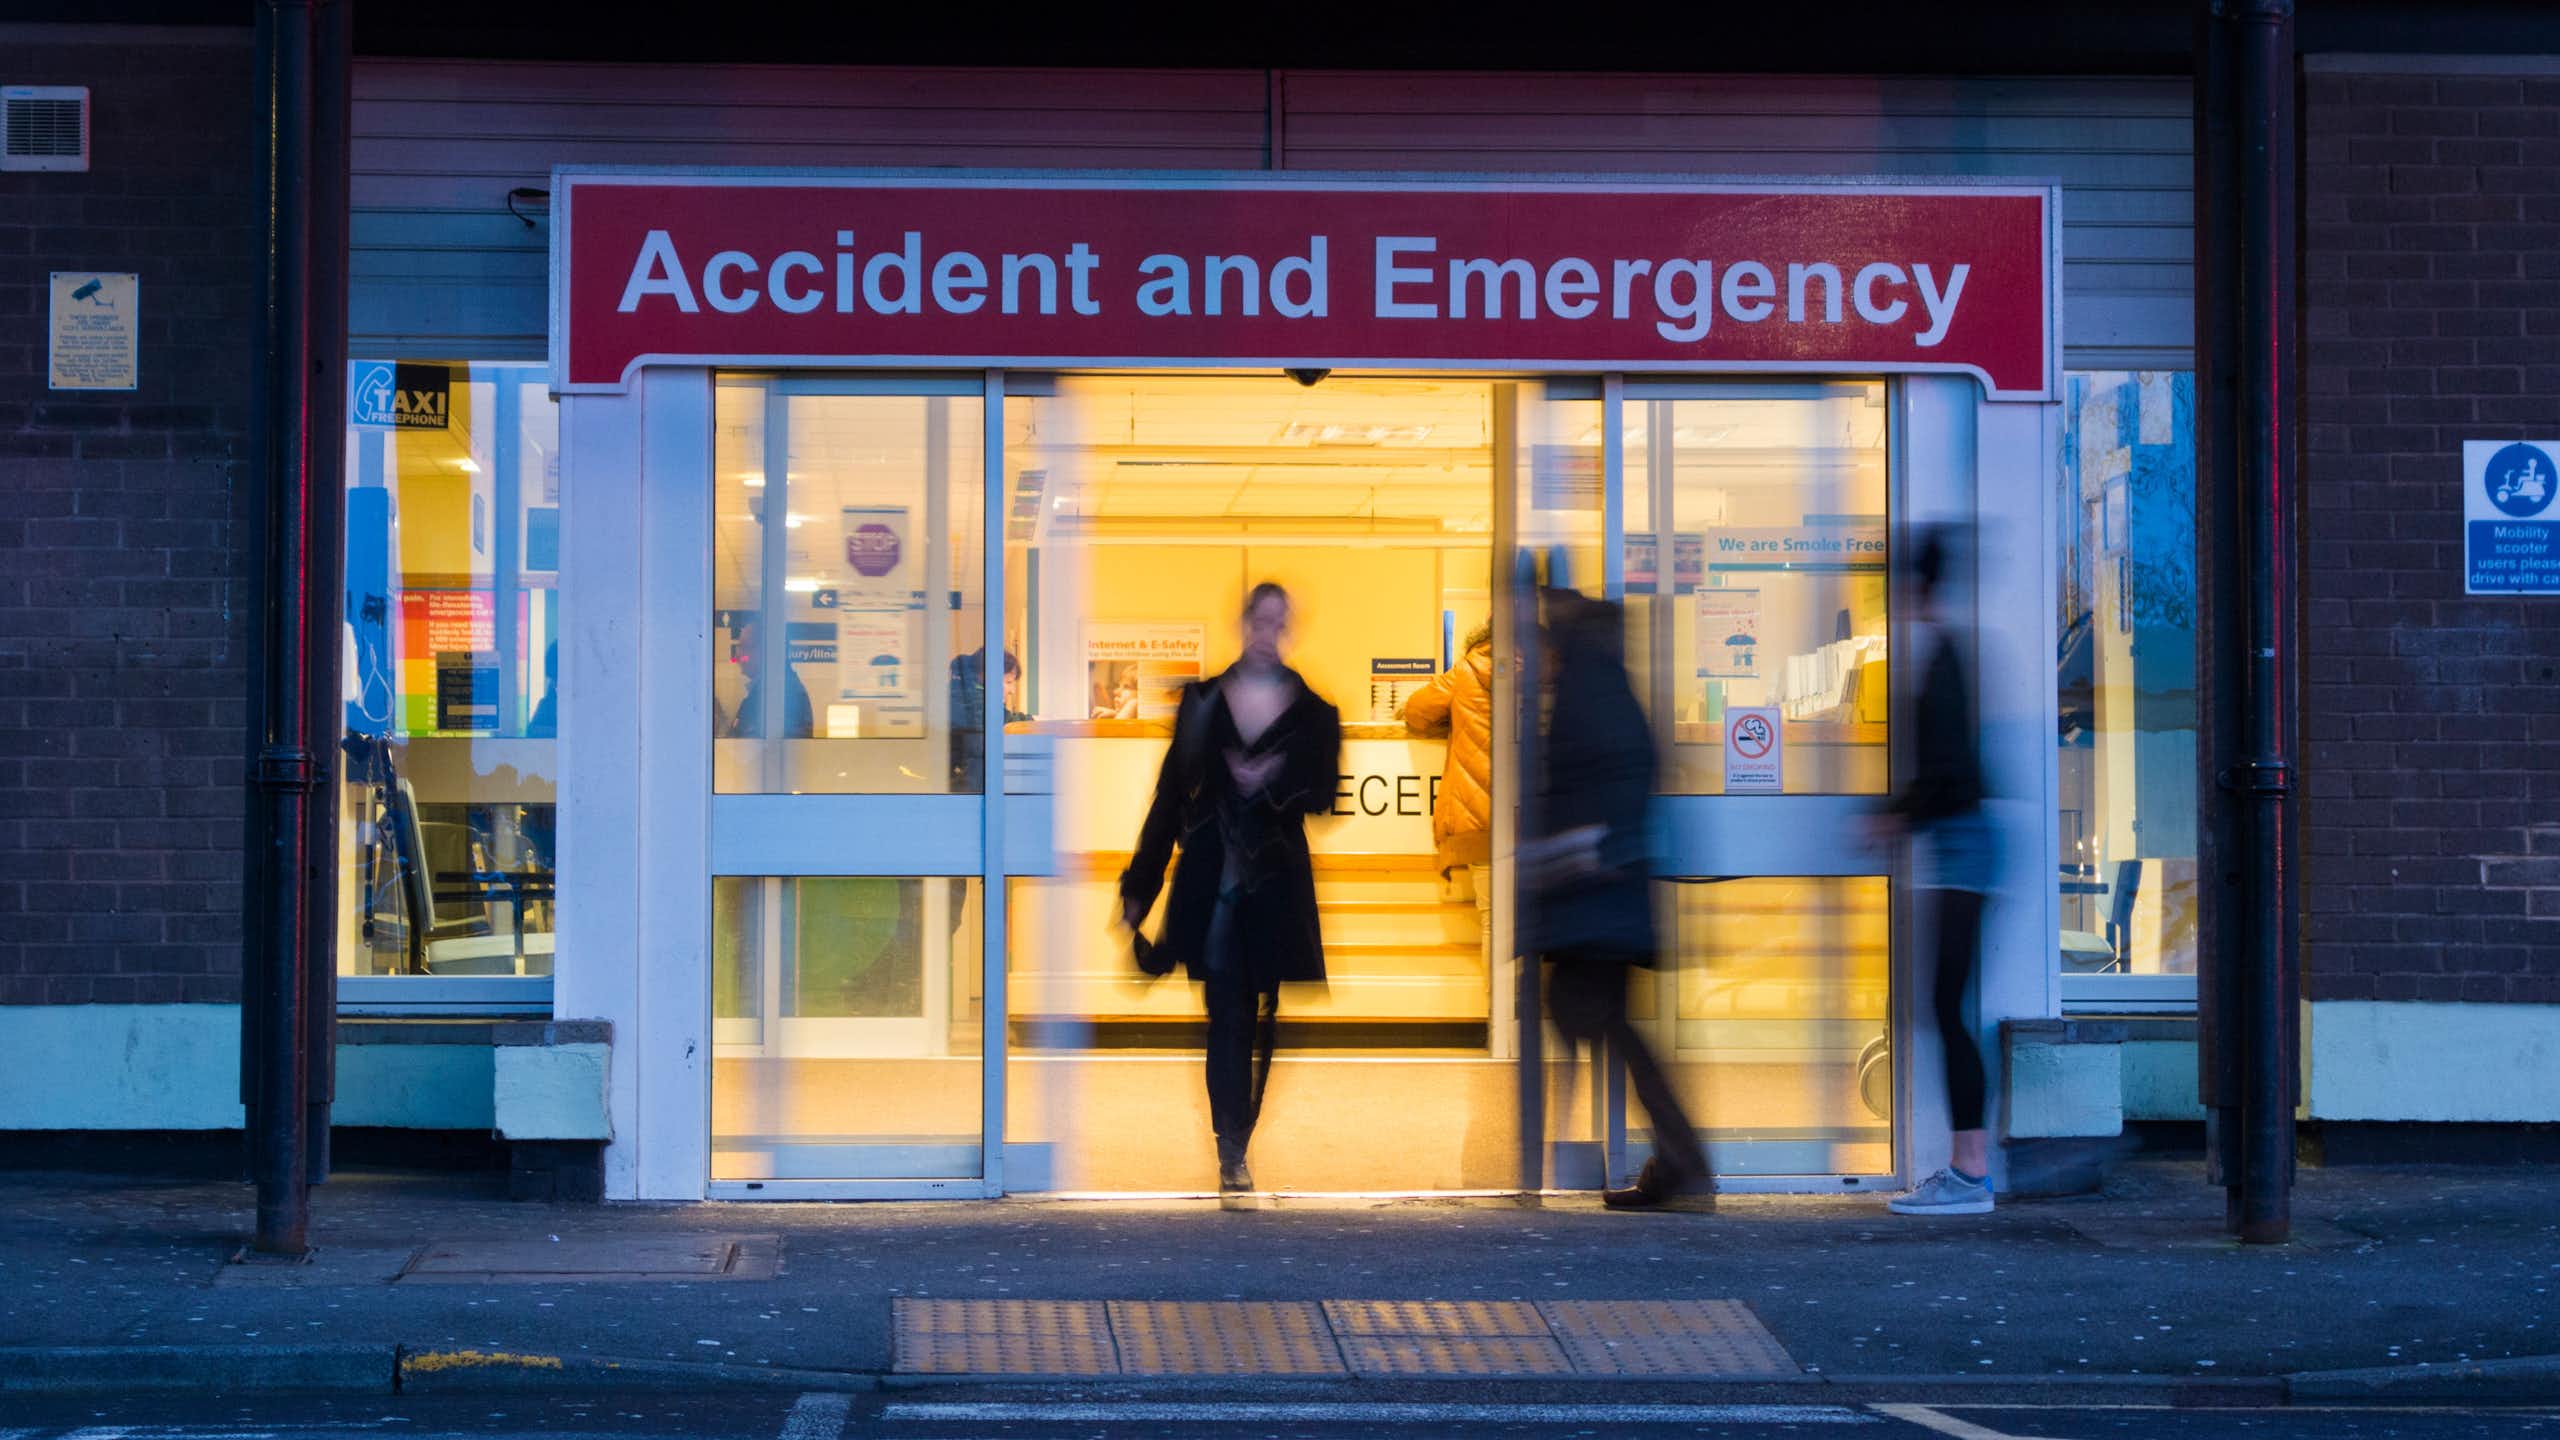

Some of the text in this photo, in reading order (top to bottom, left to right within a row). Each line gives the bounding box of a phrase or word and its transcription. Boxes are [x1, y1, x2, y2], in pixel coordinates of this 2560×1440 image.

[616, 229, 1971, 348] Accident and Emergency
[373, 388, 446, 415] TAXI
[371, 411, 446, 426] FREEPHONE
[2494, 526, 2550, 541] Mobility
[1718, 537, 1885, 551] We are Smoke Free
[2495, 541, 2549, 554] scooter
[2478, 558, 2516, 569] users
[2471, 571, 2505, 585] drive
[2509, 571, 2539, 585] with
[1088, 640, 1199, 651] Internet & E-Safety
[1329, 774, 1442, 817] ECEP
